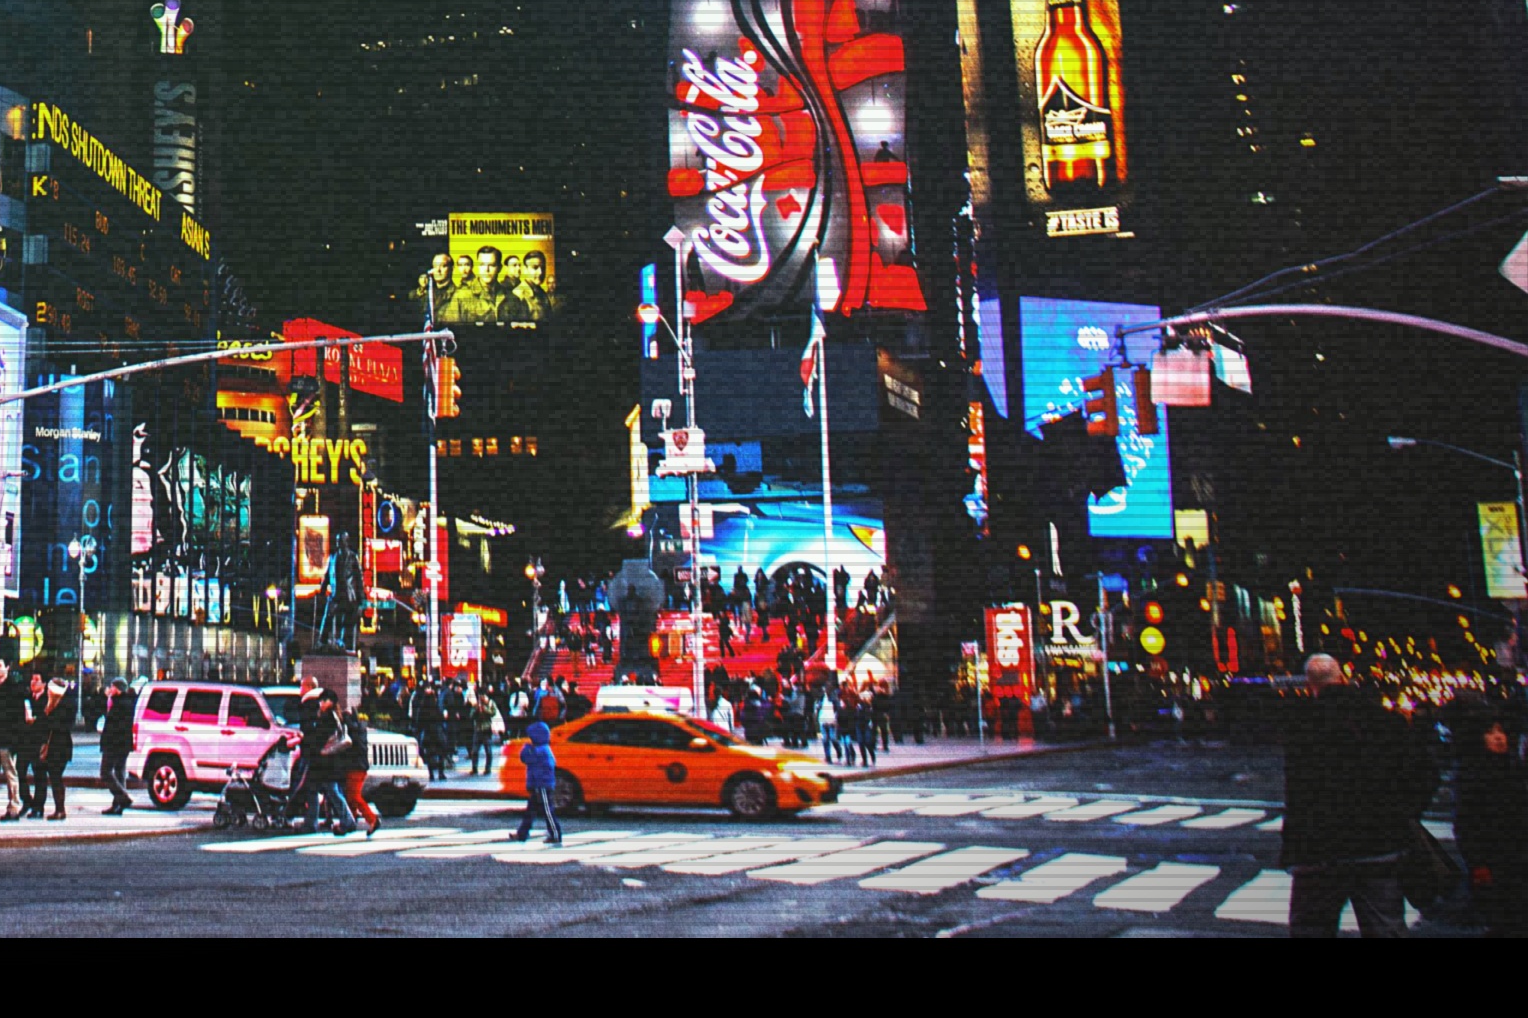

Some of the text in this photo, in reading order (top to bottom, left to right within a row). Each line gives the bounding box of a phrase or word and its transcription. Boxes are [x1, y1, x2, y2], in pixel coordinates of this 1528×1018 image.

[31, 102, 69, 150] NDS
[71, 122, 127, 206] SHUTDOWN
[128, 166, 162, 222] THREAT
[181, 211, 204, 257] ASIAN
[681, 48, 771, 285] Coca-Cola
[451, 220, 469, 236] THE
[469, 219, 530, 236] MONUMENTS
[531, 218, 553, 236] MEN
[35, 426, 71, 439] Morgan
